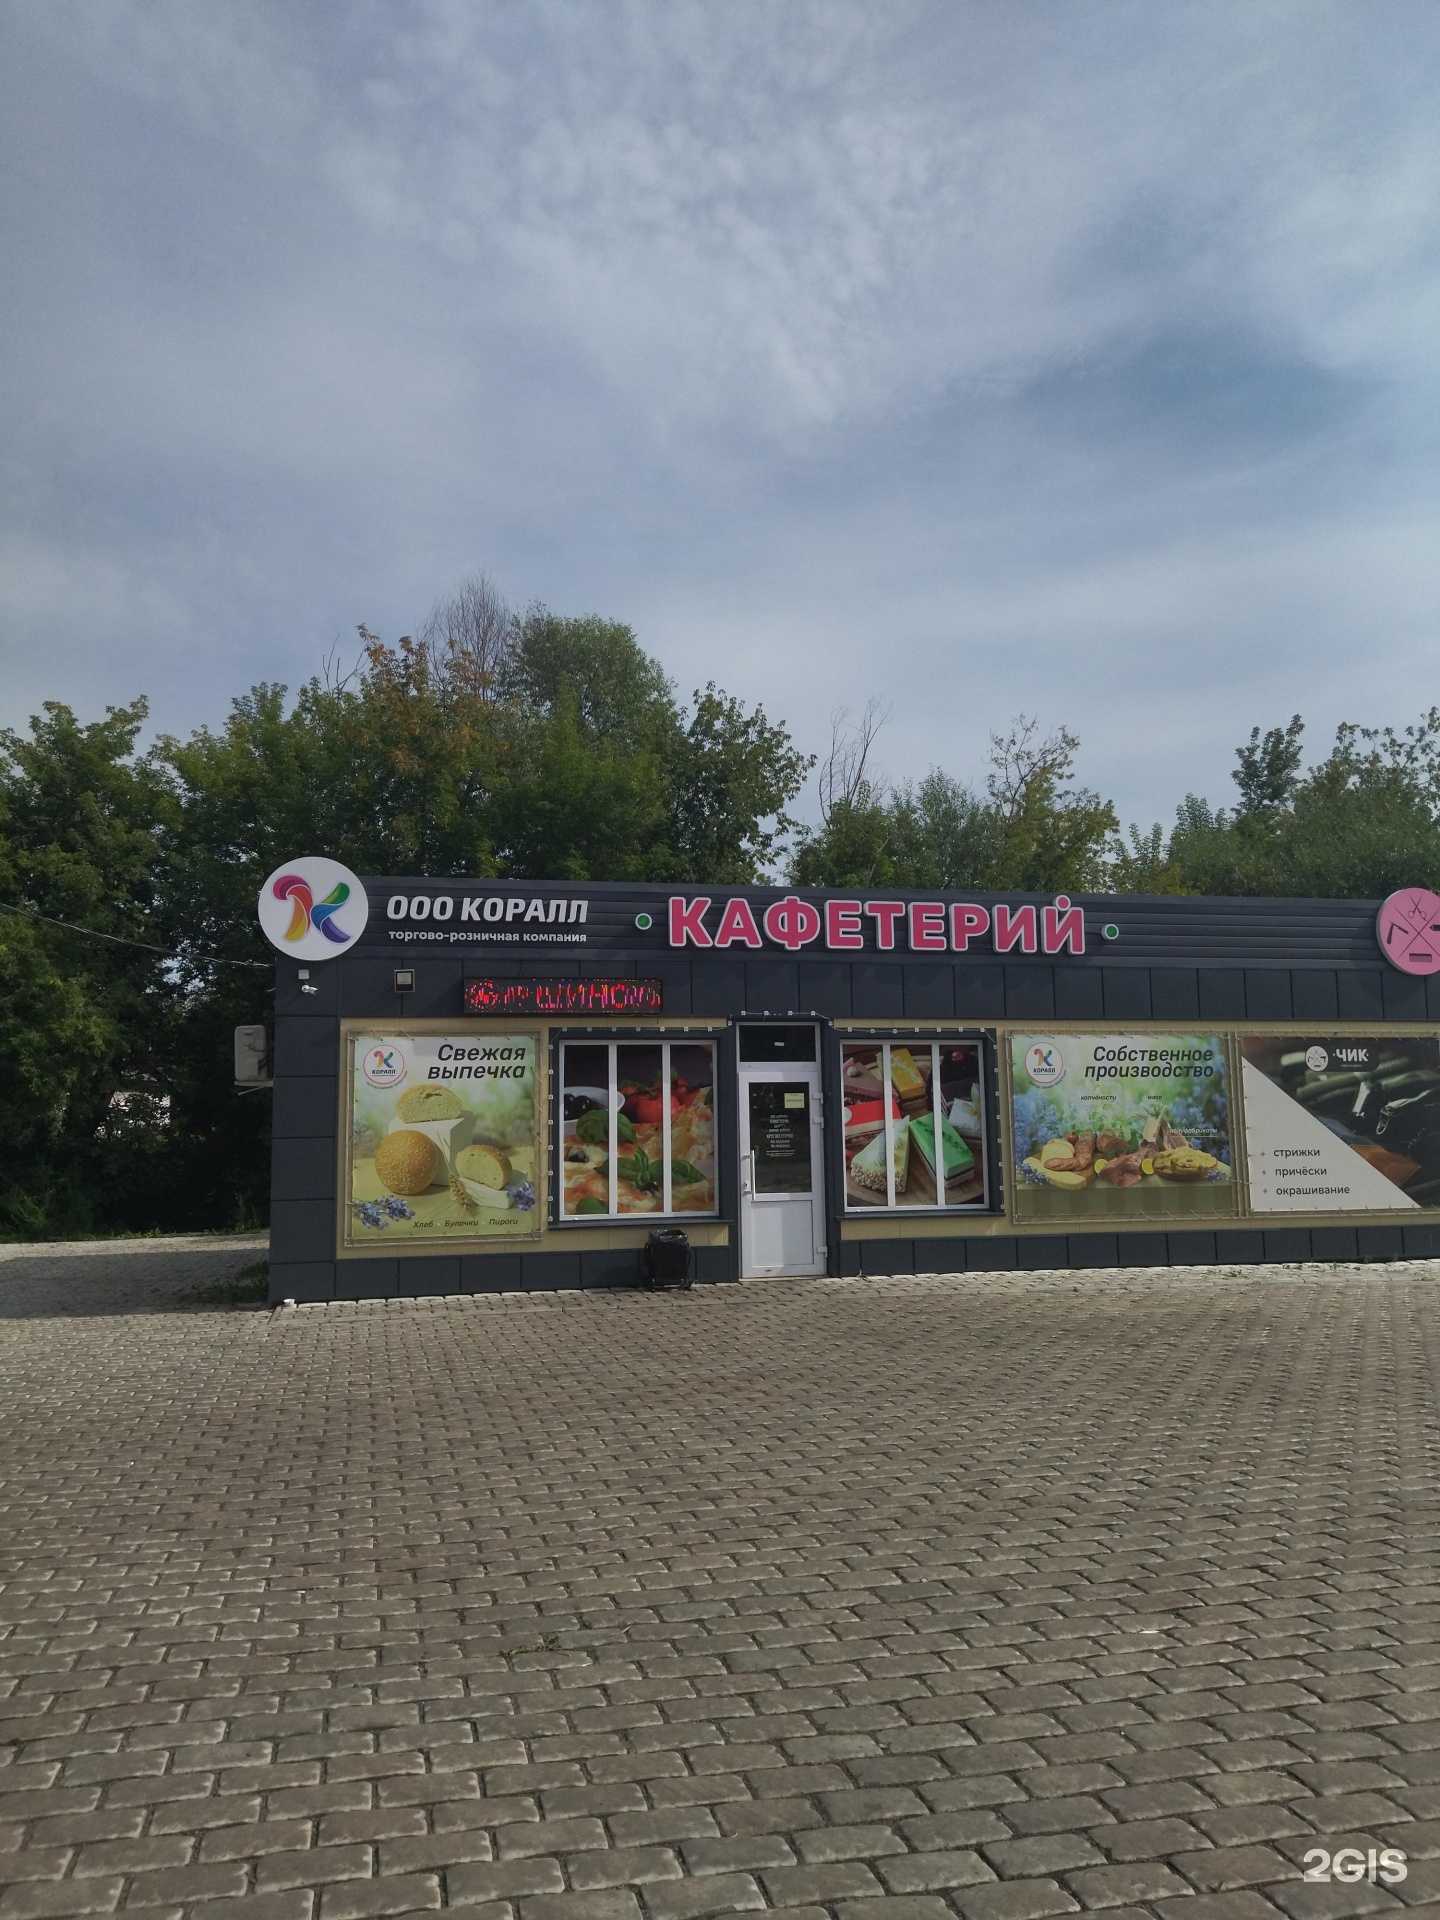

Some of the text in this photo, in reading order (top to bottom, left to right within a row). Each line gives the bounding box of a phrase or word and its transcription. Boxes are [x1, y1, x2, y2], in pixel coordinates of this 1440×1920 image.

[386, 895, 589, 923] ООО КОРАЛЛ
[668, 895, 1086, 955] КАФЕТЕРИЙ
[388, 930, 587, 943] торгово-розничная компания
[437, 1044, 526, 1061] Свежая
[1093, 1045, 1214, 1061] Собственное
[427, 1065, 526, 1080] выпечка
[1084, 1061, 1214, 1081] производство
[1273, 1149, 1320, 1160] стрижки
[1274, 1166, 1328, 1178] причёски
[1275, 1186, 1350, 1197] окрашивание
